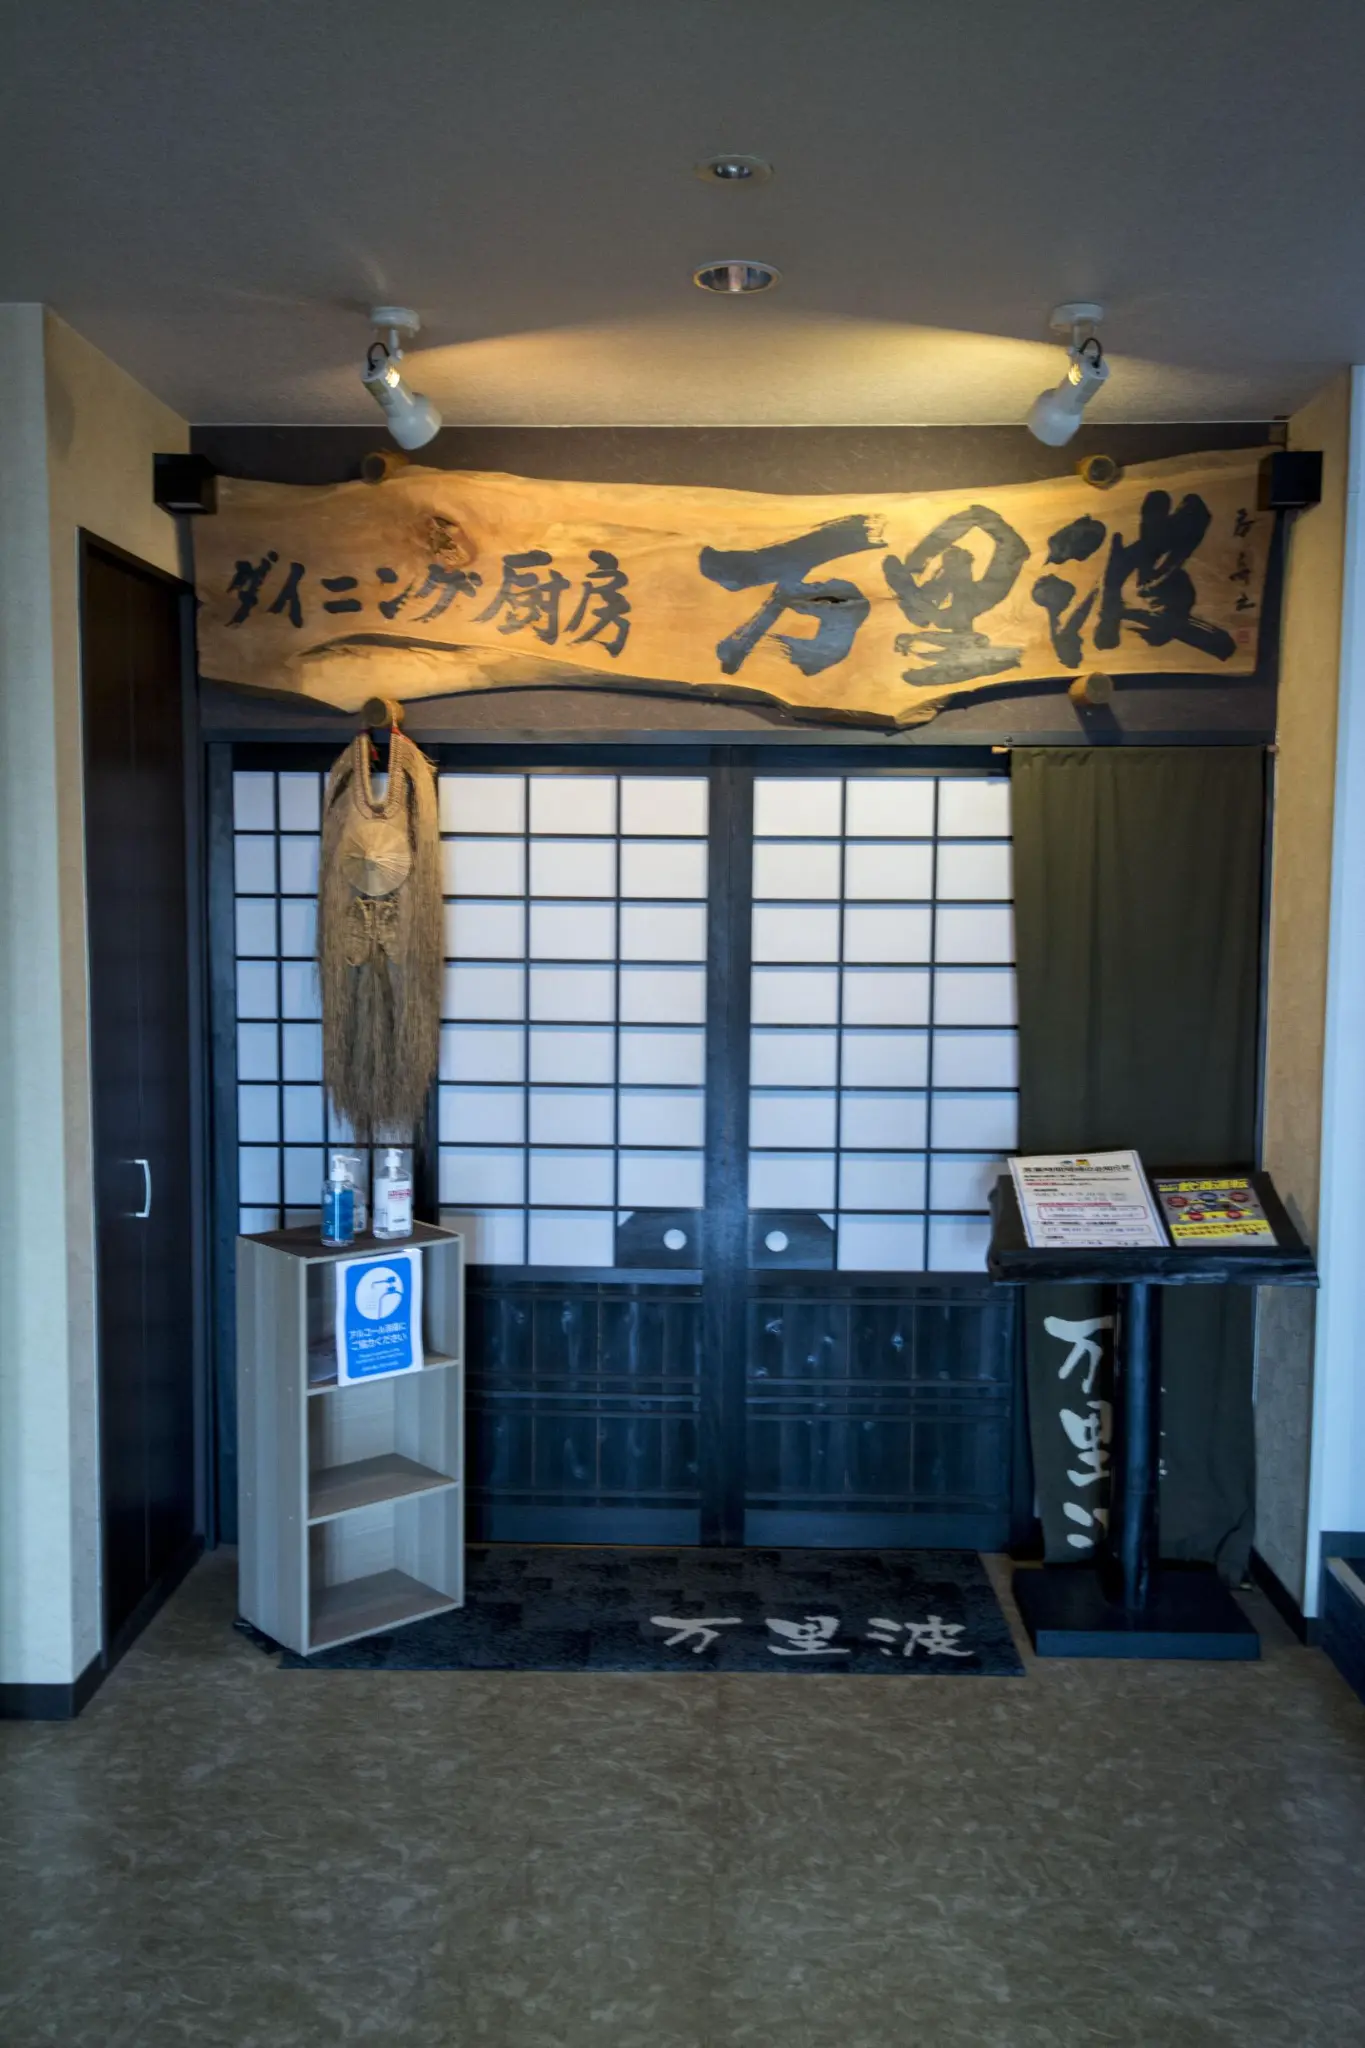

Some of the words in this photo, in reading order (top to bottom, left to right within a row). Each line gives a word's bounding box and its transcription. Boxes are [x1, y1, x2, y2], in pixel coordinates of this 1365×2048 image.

[224, 549, 632, 658] ダイニング厨房
[698, 489, 1238, 687] 万里波
[649, 1614, 976, 1657] 万里波
